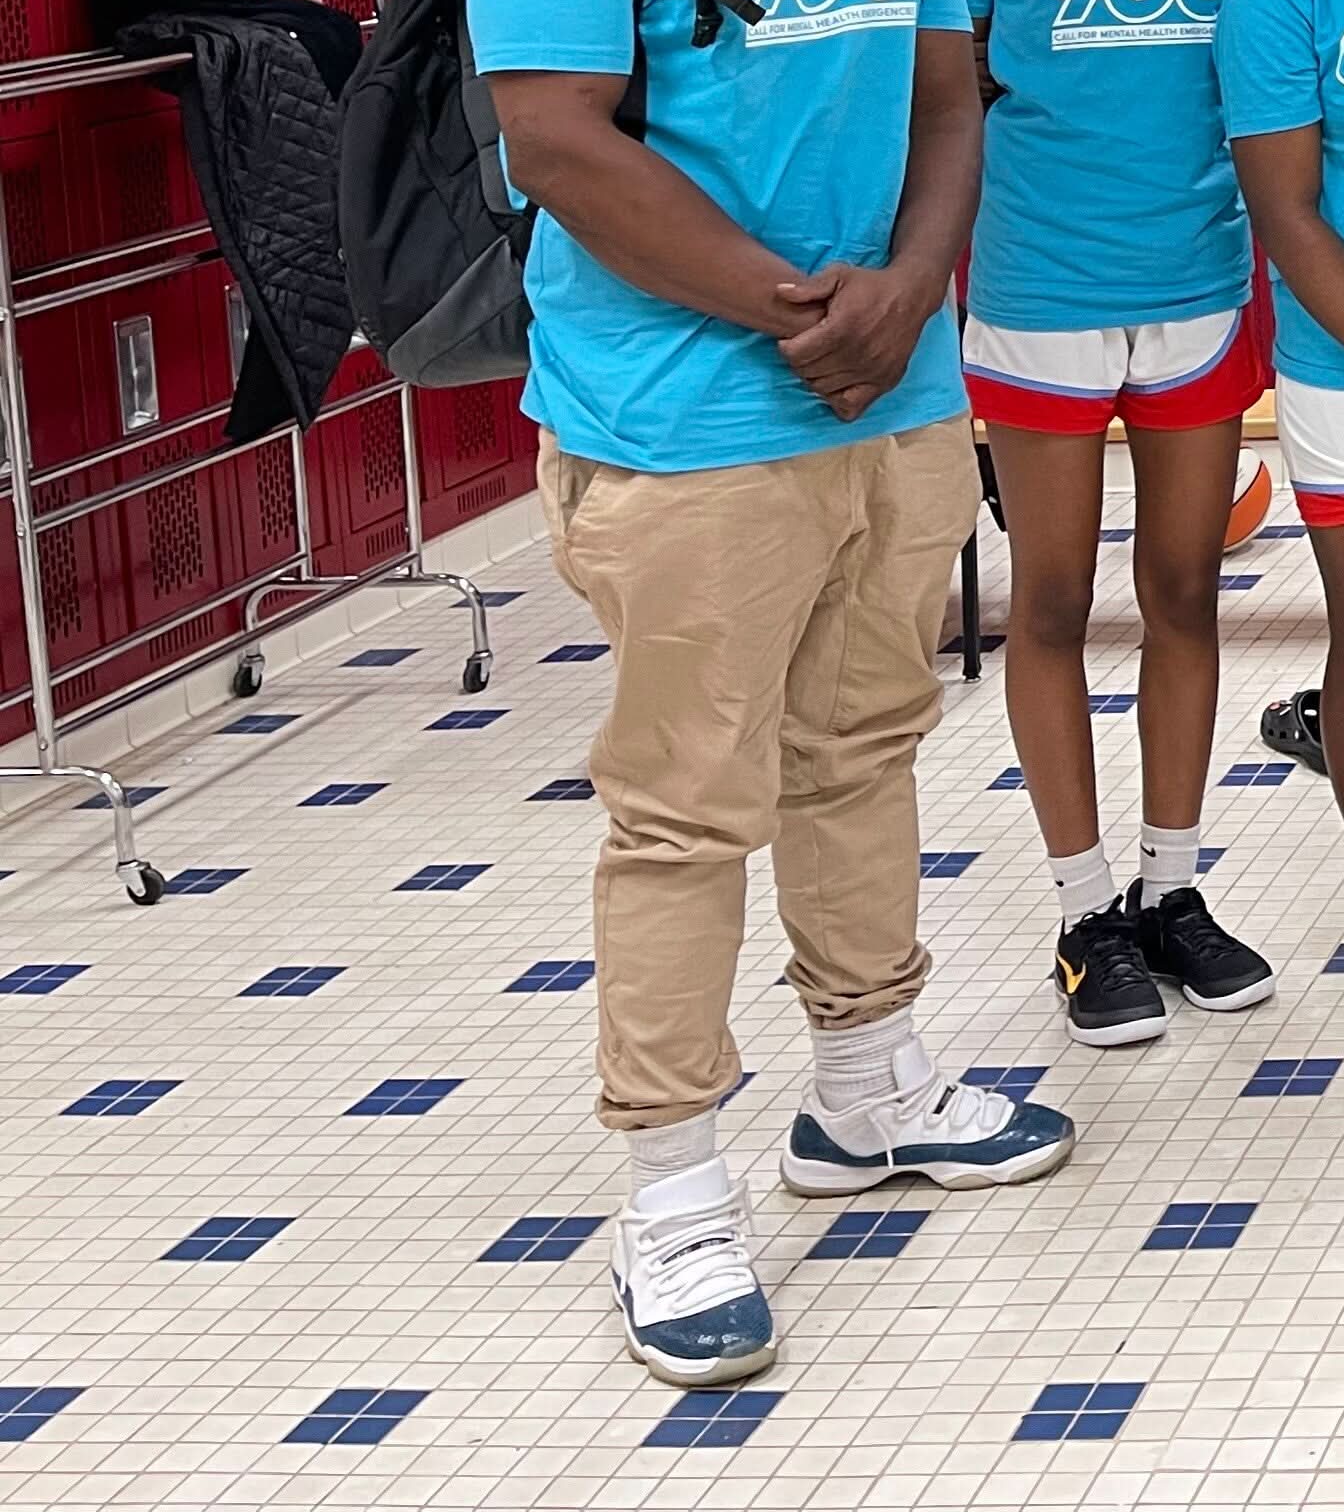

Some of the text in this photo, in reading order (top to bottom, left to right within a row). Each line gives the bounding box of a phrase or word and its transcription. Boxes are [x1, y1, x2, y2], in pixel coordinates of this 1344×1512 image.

[815, 10, 860, 29] HEALTH
[1054, 31, 1077, 42] CALL
[1078, 30, 1097, 40] FOR
[1100, 29, 1136, 39] MENTAL
[1138, 27, 1178, 37] HEALTH
